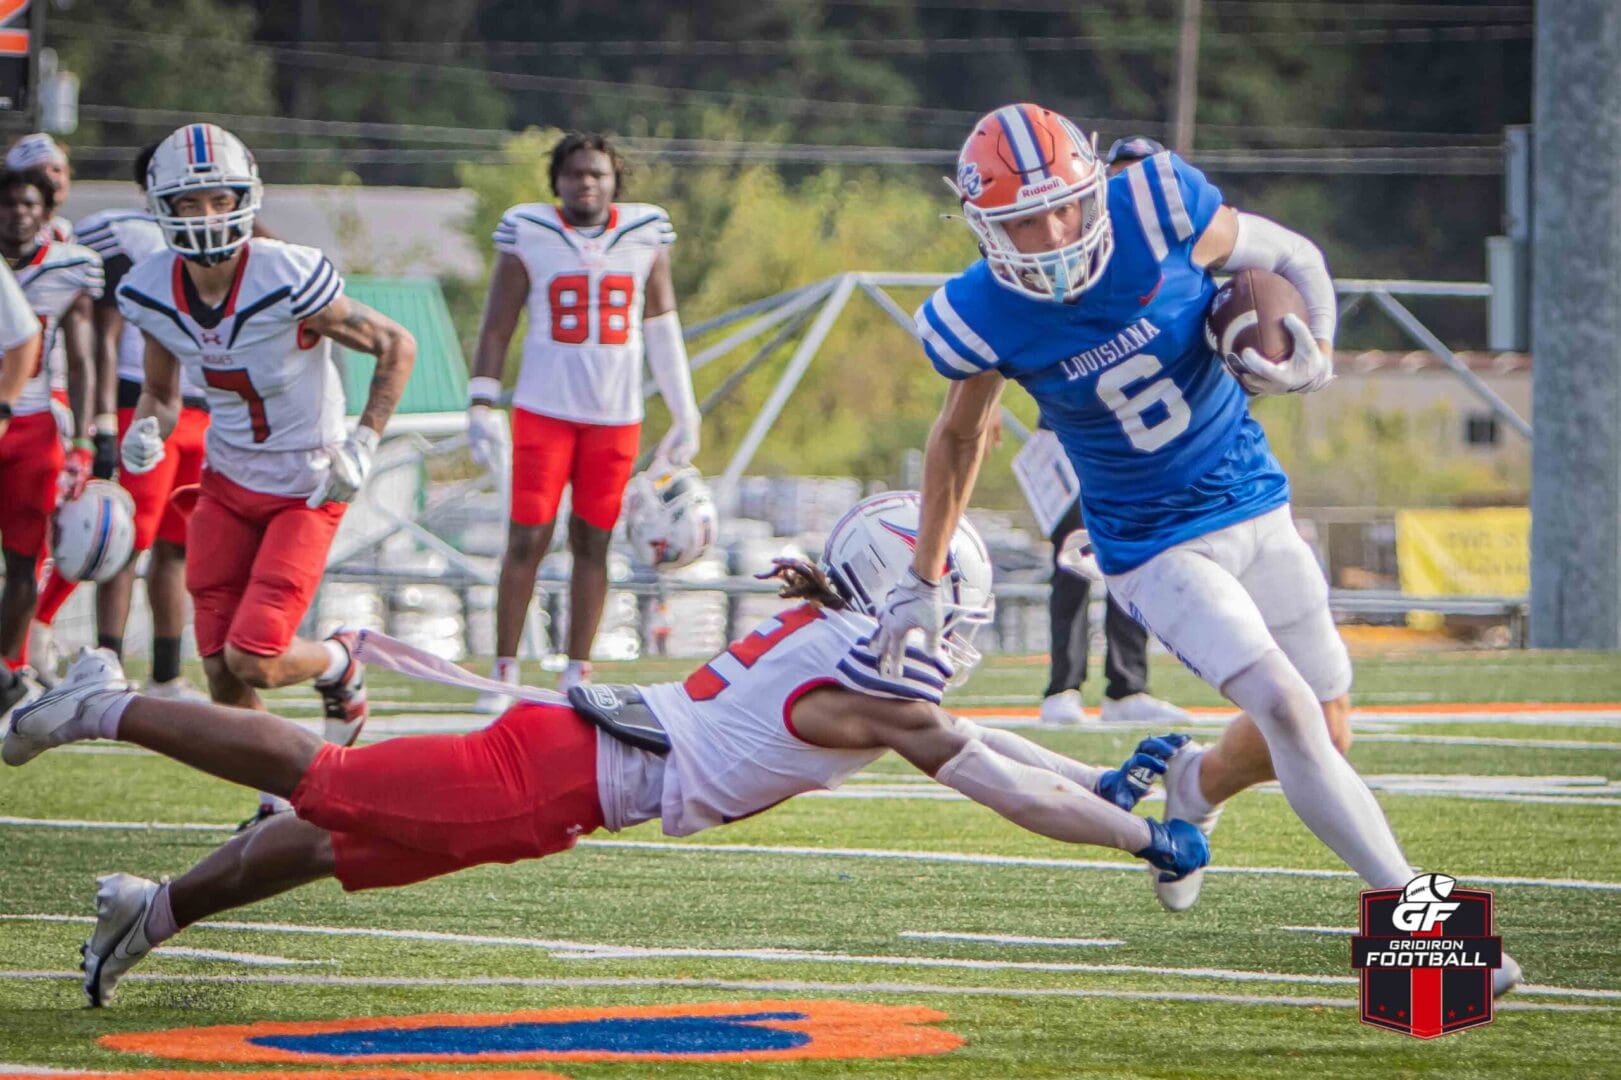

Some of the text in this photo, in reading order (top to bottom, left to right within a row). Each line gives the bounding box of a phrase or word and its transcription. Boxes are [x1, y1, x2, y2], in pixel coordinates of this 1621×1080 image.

[1022, 179, 1060, 198] Riddell
[548, 272, 634, 344] 88
[1060, 317, 1161, 381] LOUISIANA
[201, 365, 272, 444] 7
[1096, 353, 1192, 452] 6
